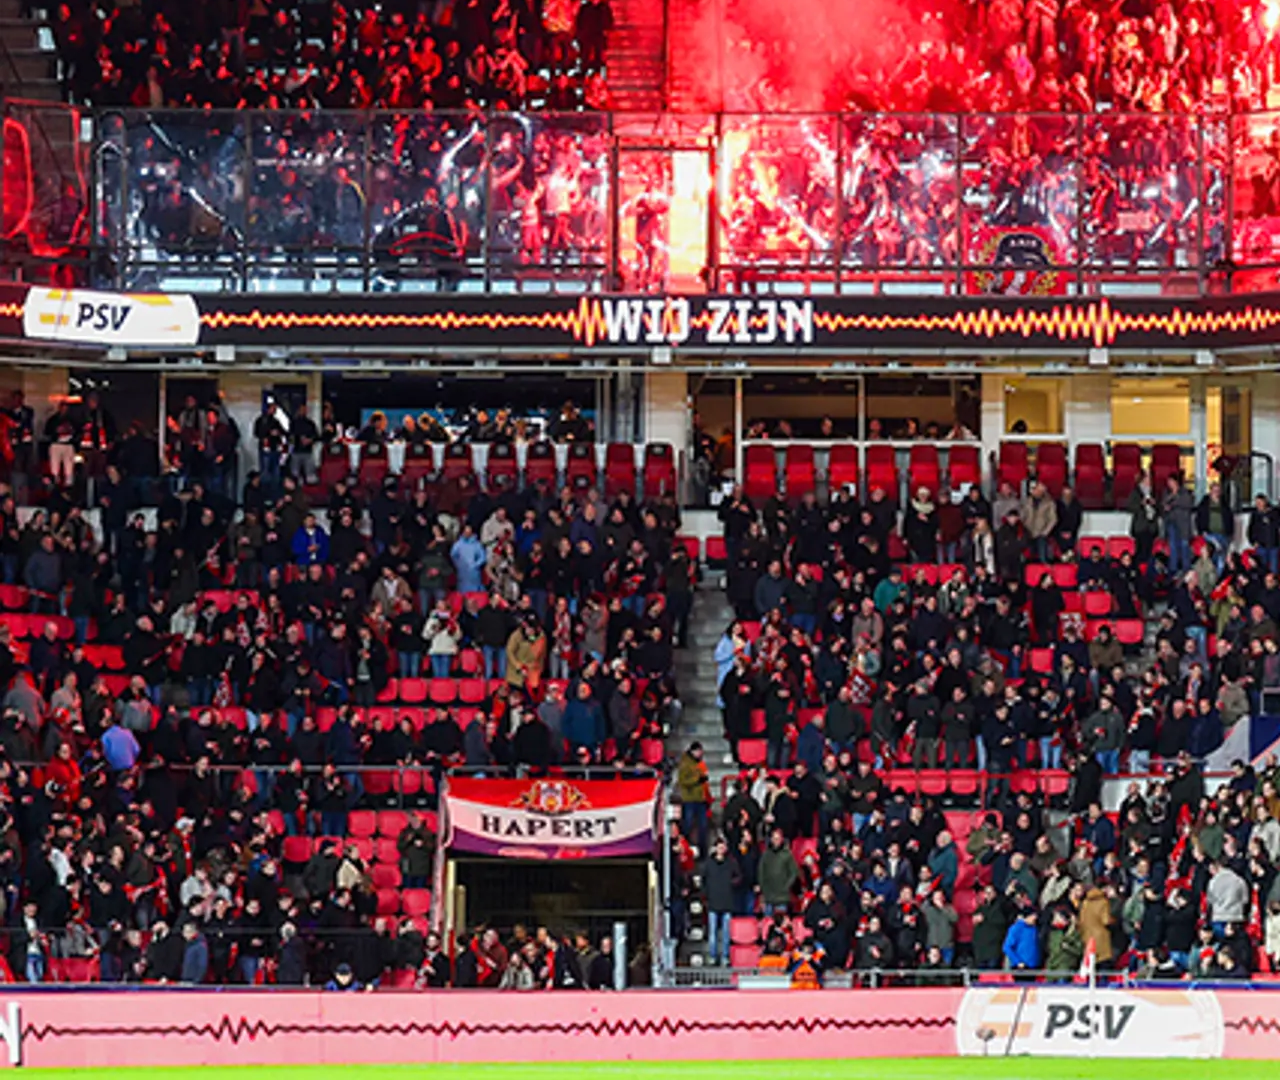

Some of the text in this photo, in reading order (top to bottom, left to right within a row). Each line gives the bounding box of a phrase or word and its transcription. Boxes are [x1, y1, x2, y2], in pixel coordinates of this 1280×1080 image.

[76, 302, 132, 331] PSV
[707, 300, 813, 343] ZIJN
[481, 814, 616, 838] HAPERT
[1044, 1004, 1135, 1039] PSV
